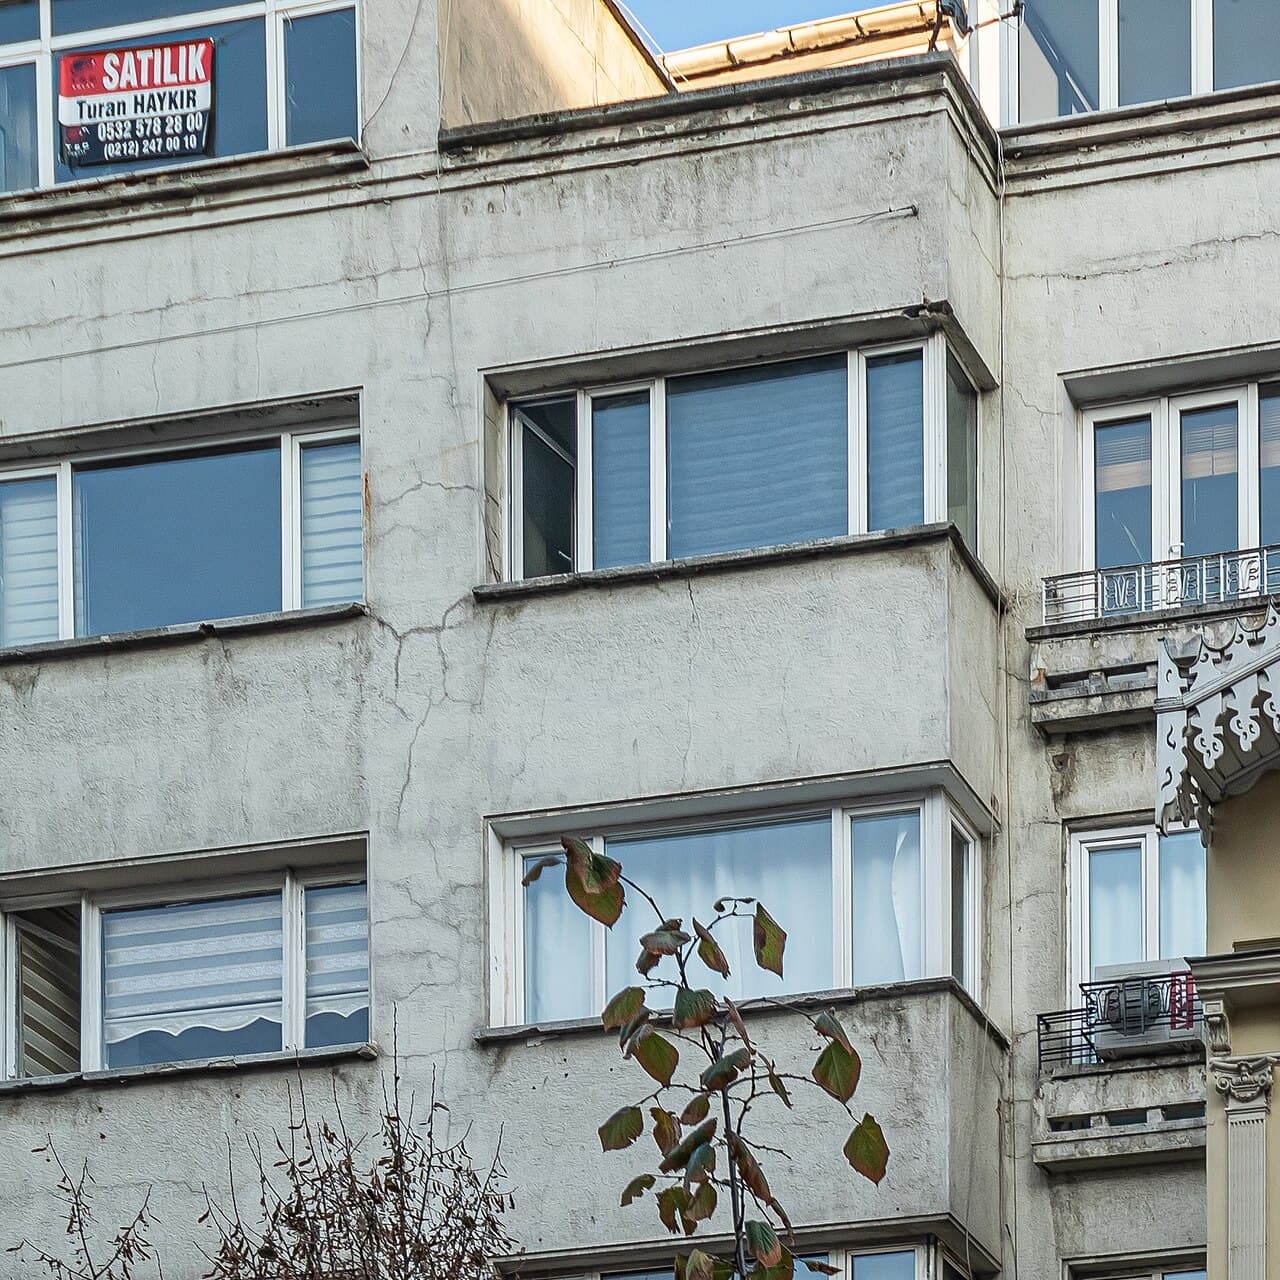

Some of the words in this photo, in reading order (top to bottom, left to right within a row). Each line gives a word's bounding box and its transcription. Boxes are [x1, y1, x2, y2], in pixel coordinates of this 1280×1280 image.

[102, 43, 206, 91] SATILIK
[76, 99, 127, 120] Turan
[133, 88, 198, 114] HAYKIR
[97, 120, 132, 142] 0532
[135, 116, 162, 138] 578
[165, 114, 183, 135] 28
[186, 111, 203, 130] 00
[103, 139, 140, 160] (0212)
[142, 137, 163, 154] 247
[166, 135, 180, 150] 00
[183, 133, 197, 149] 10
